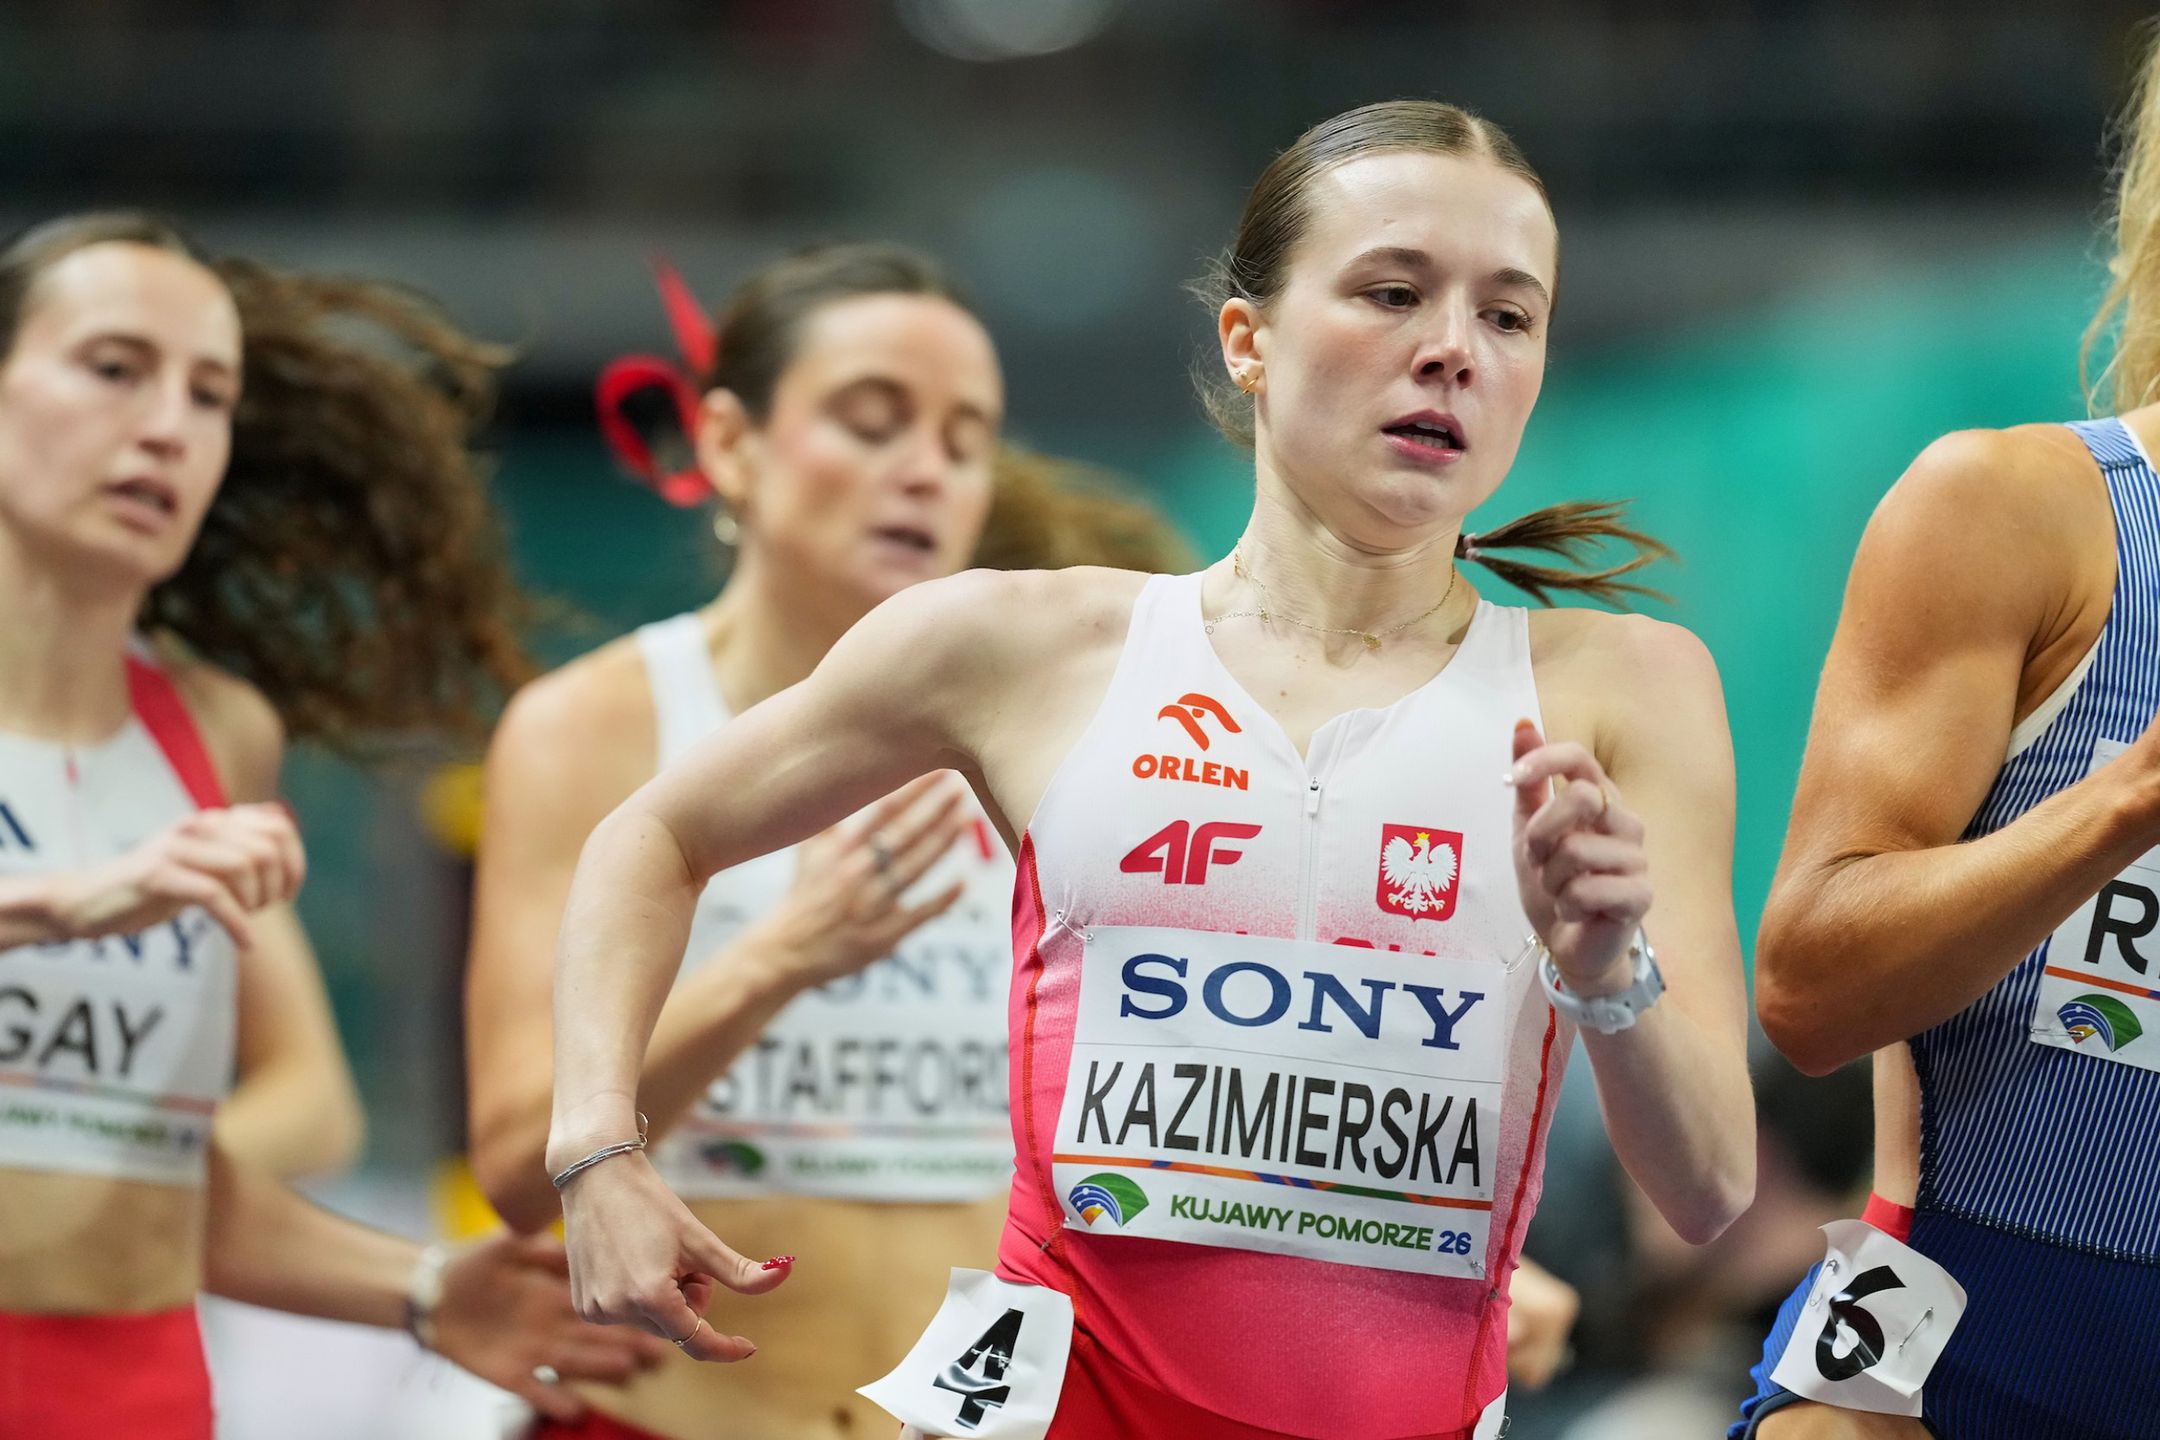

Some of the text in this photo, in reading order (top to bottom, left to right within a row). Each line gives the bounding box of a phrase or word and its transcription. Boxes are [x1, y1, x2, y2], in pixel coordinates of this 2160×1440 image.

[1132, 753, 1249, 791] ORLEN
[1119, 819, 1263, 885] 4F
[1119, 952, 1485, 1051] SONY
[1076, 1059, 1482, 1188] KAZIMIERSKA
[1169, 1193, 1473, 1256] KUJAWY POMORZE 26
[932, 1307, 1024, 1430] 4
[1816, 1265, 1907, 1381] 6
